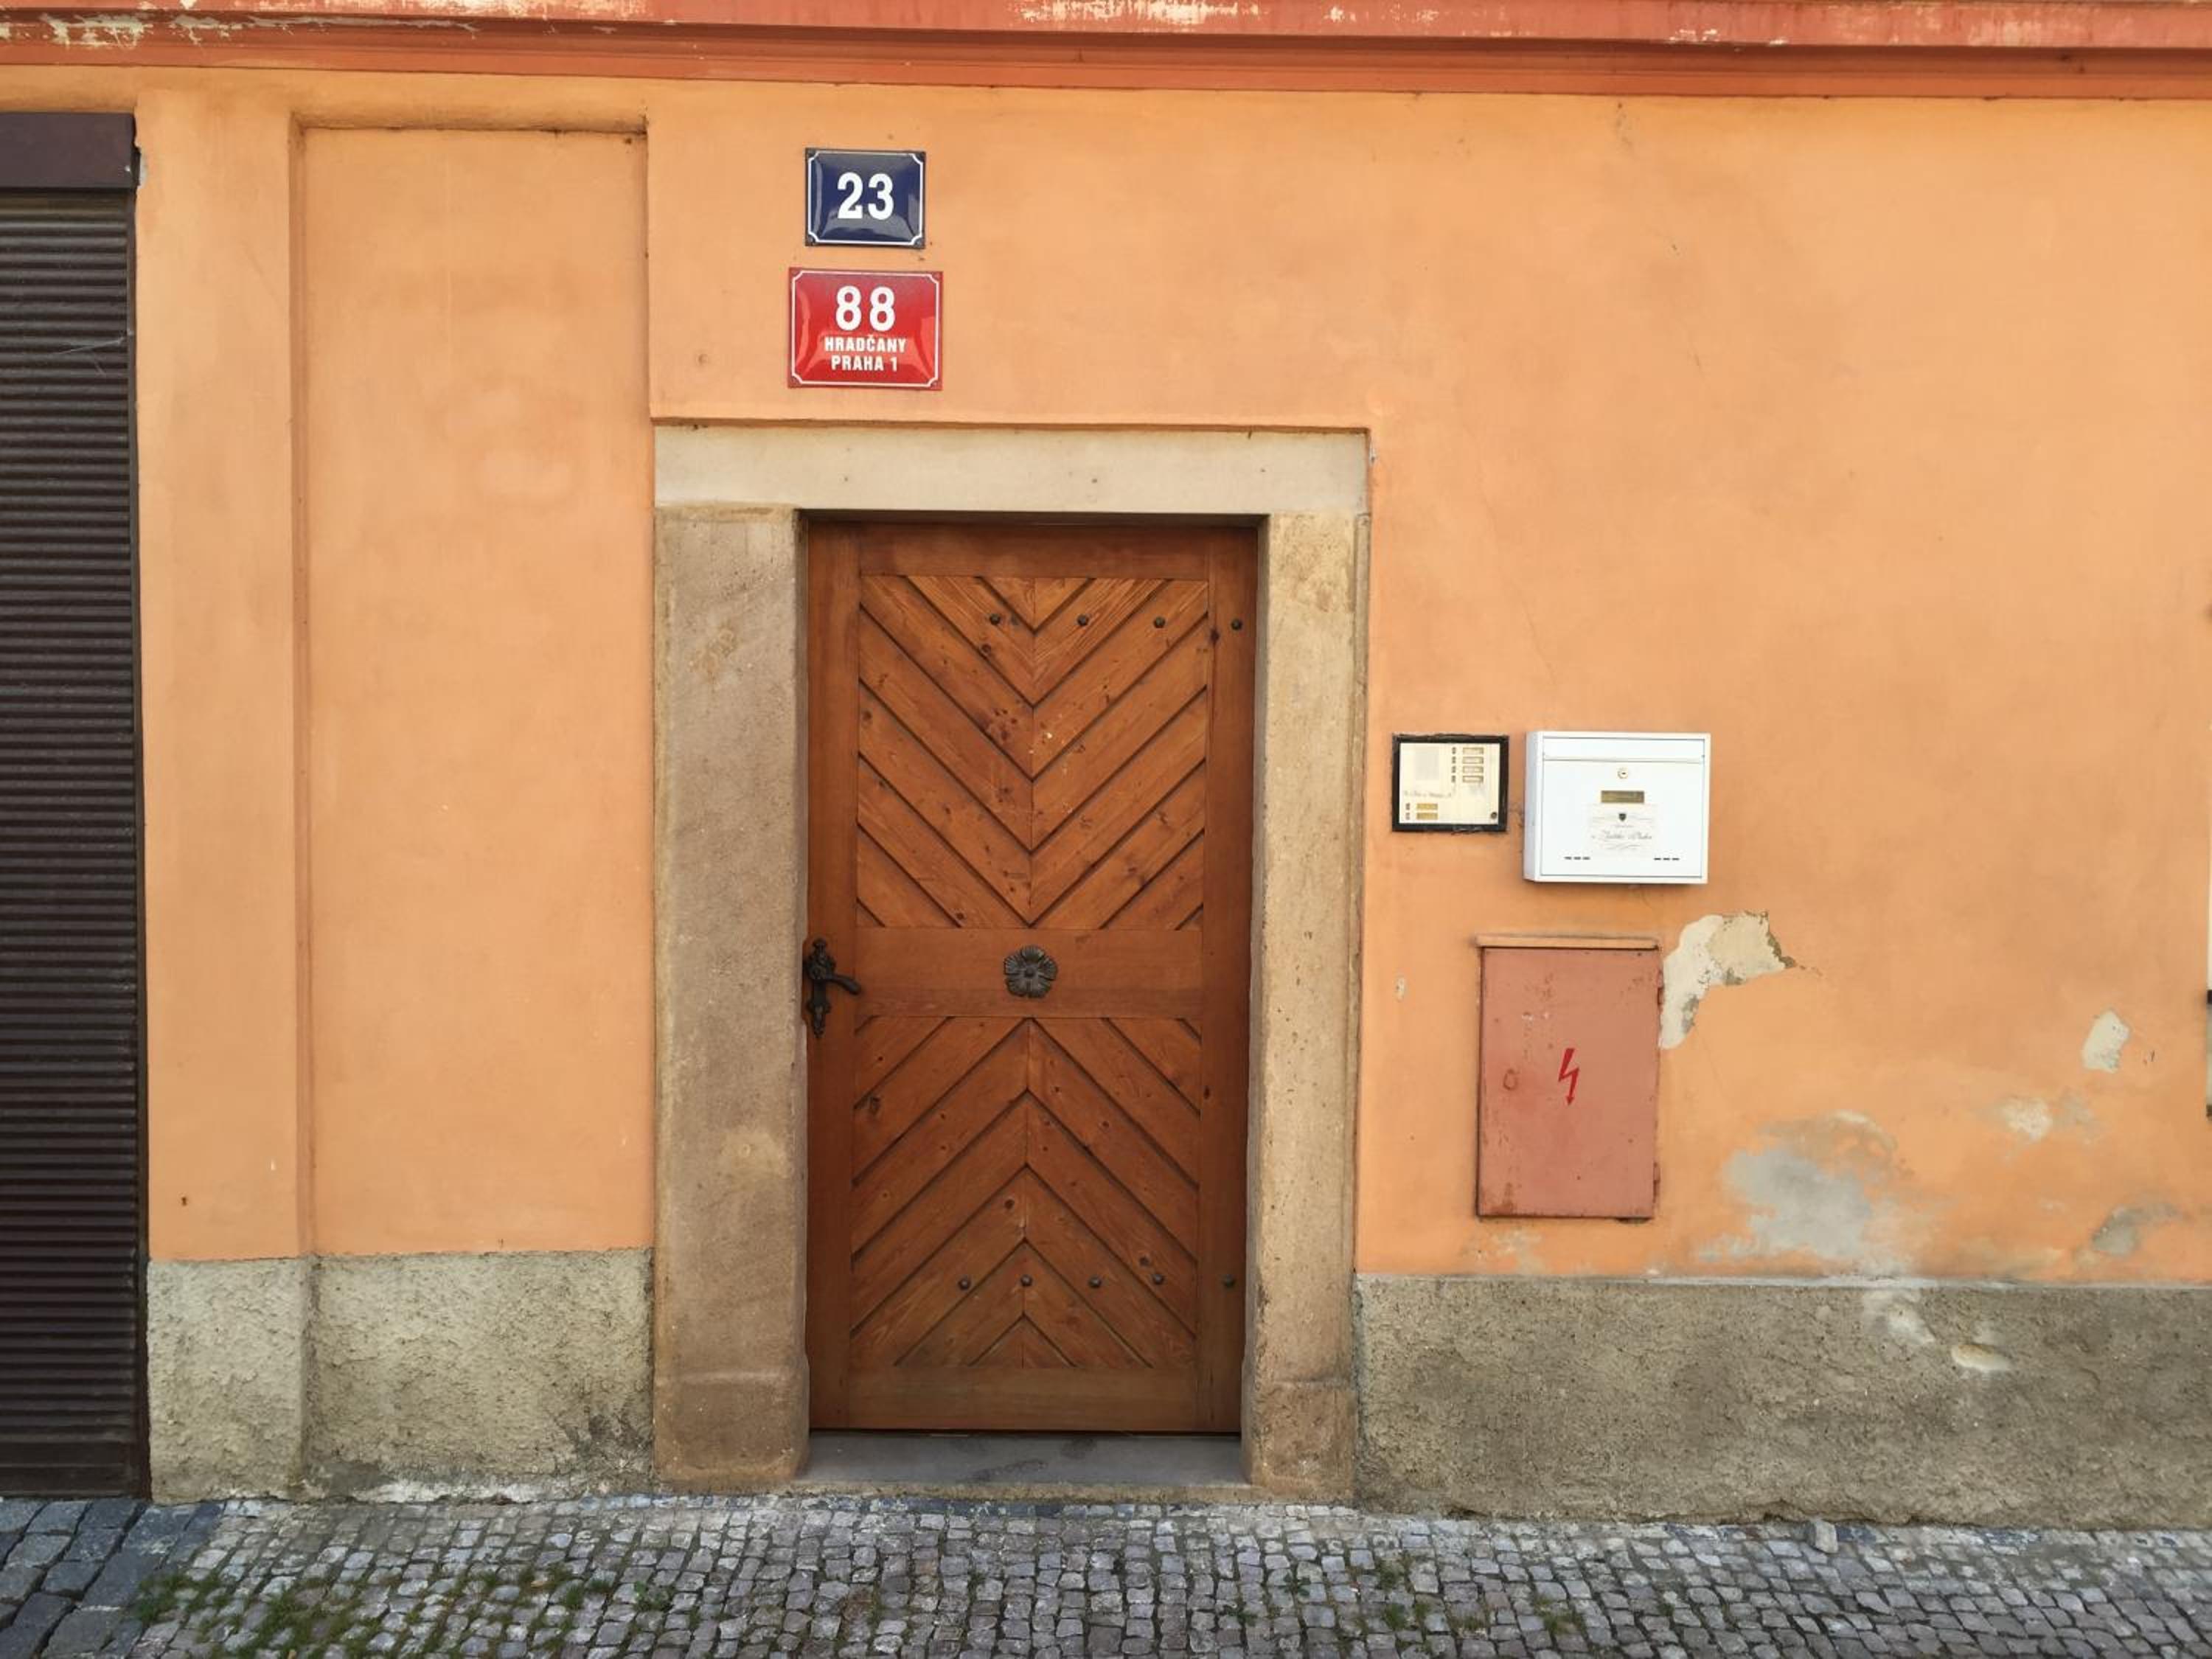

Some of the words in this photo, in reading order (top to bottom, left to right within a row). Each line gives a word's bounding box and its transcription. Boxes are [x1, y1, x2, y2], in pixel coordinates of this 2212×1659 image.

[837, 172, 894, 220] 23
[835, 285, 896, 331] 88
[824, 334, 906, 352] HRADČANY
[831, 355, 884, 371] PRAHA
[890, 356, 897, 372] 1
